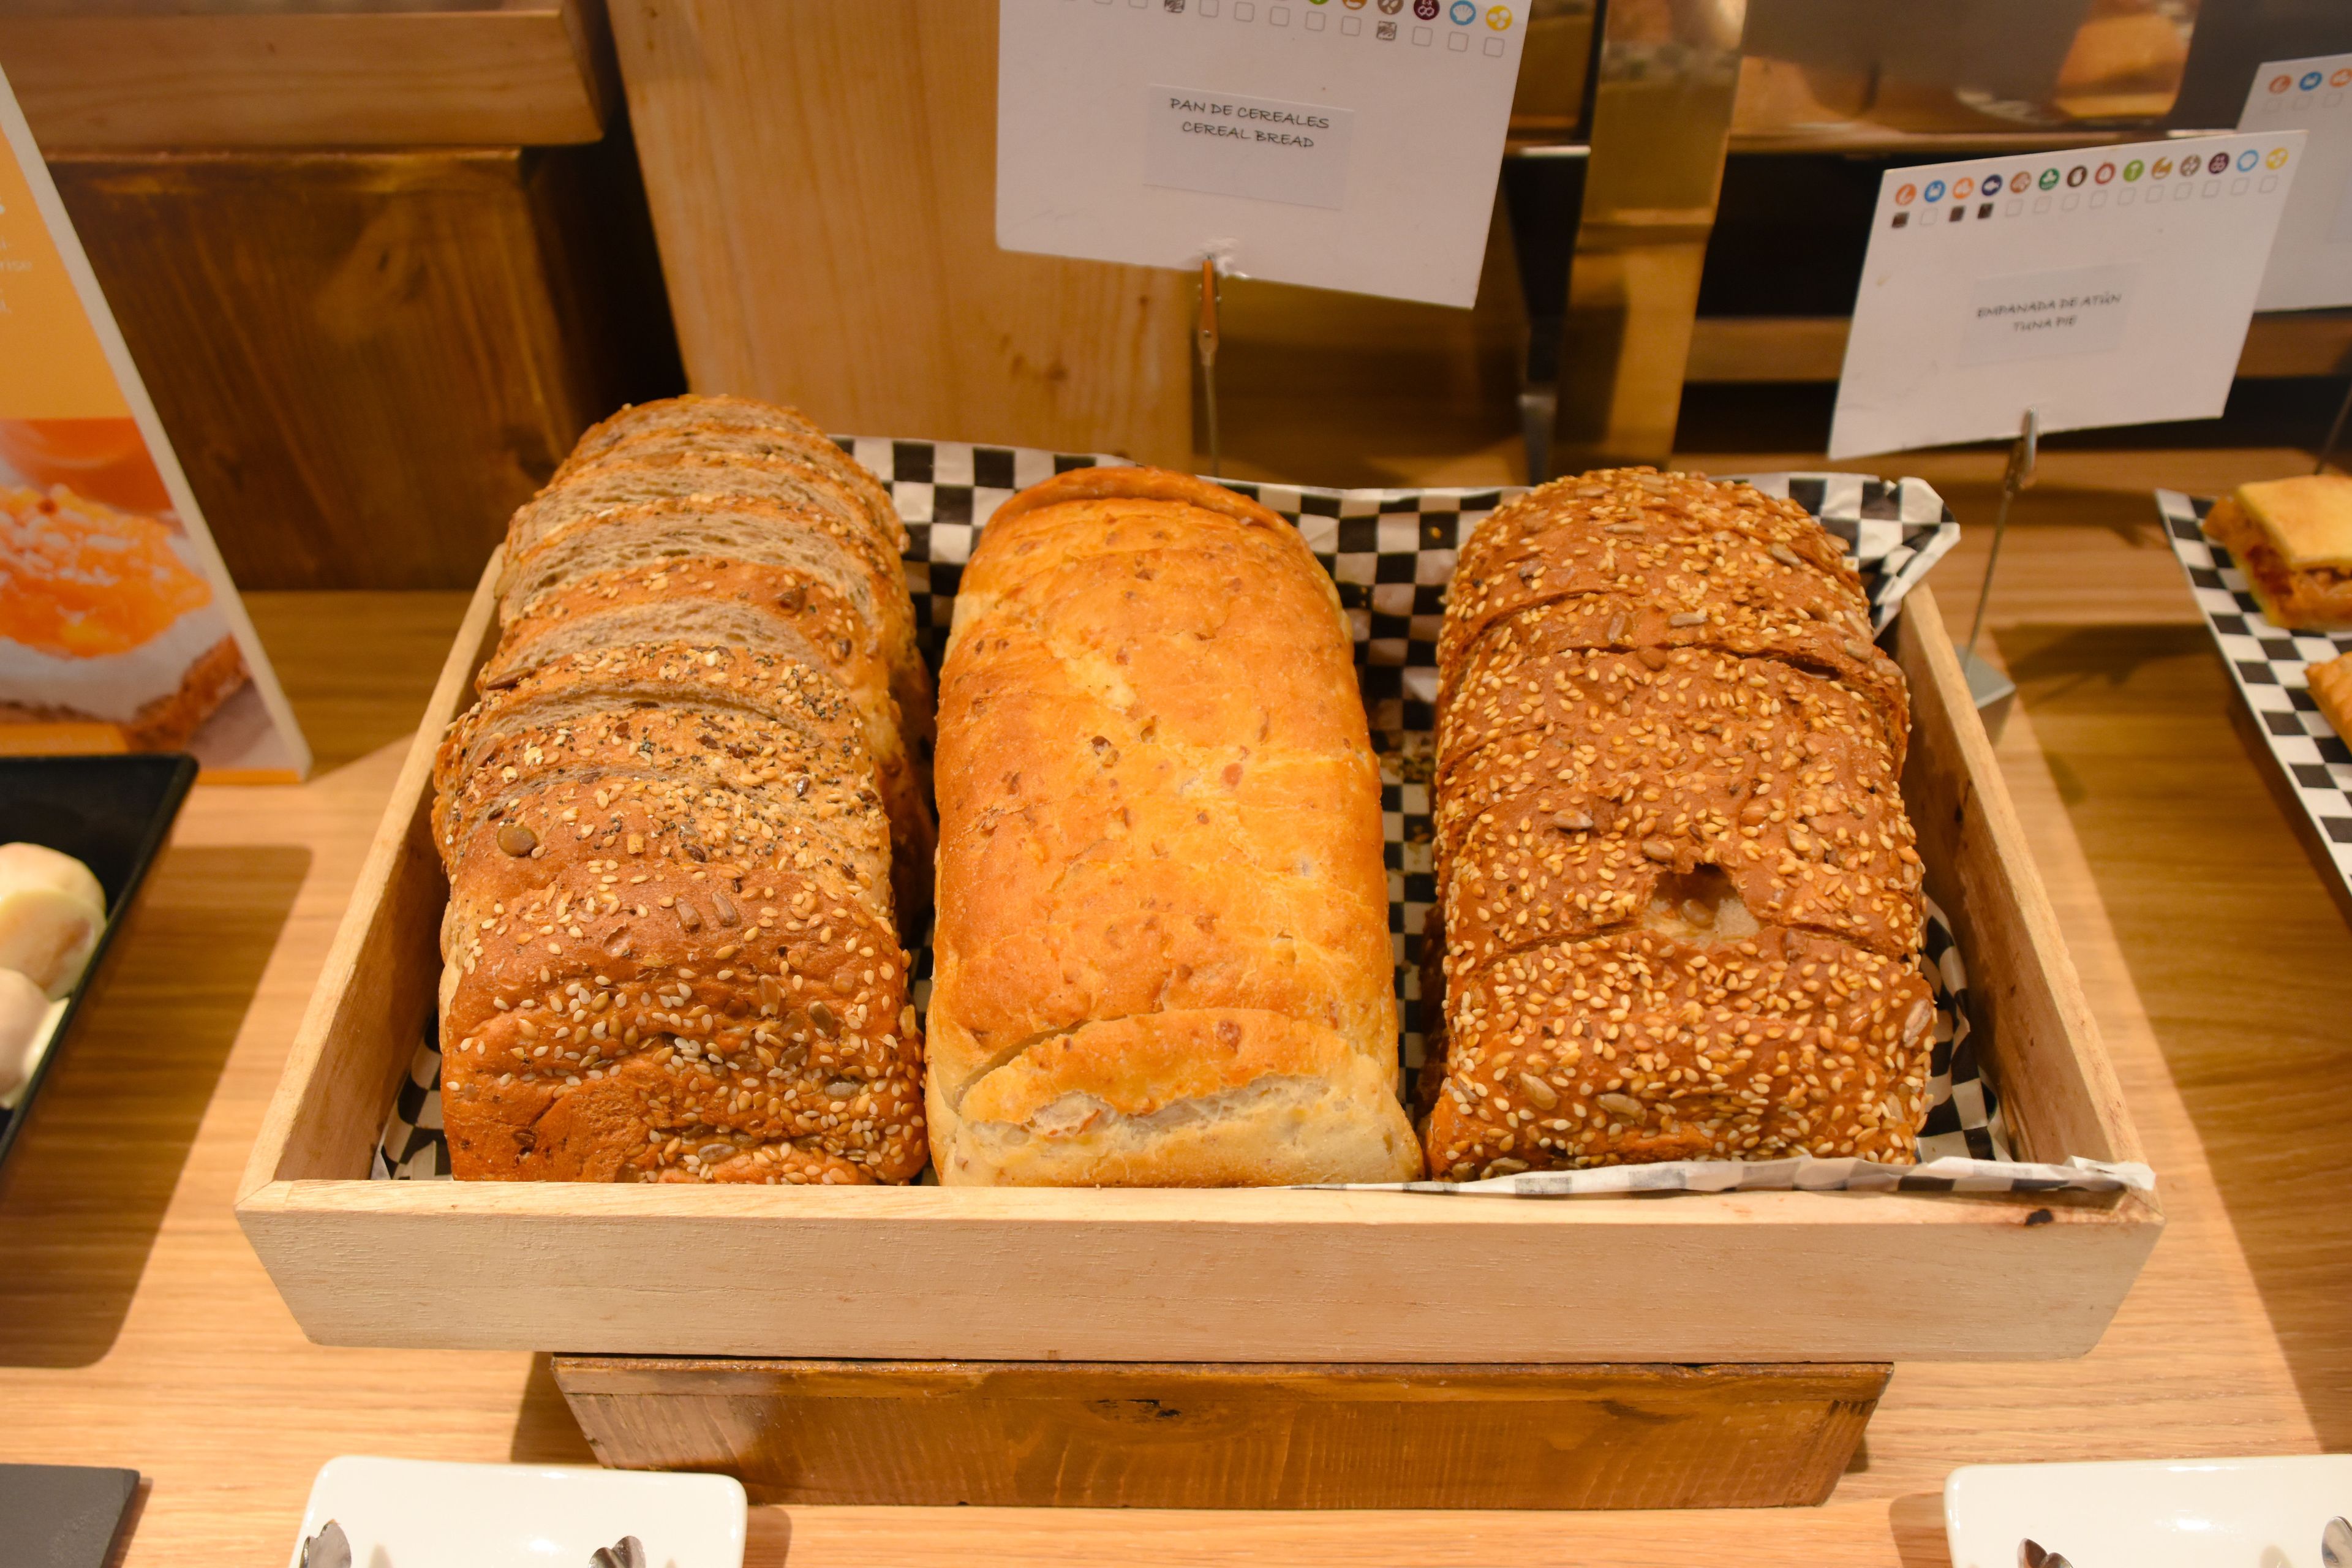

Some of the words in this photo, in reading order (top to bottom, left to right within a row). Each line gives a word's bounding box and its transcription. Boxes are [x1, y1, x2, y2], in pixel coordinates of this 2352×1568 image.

[1170, 98, 1205, 113] PAN
[1211, 103, 1233, 116] DE
[1237, 107, 1330, 129] CEREALES
[1182, 121, 1251, 140] CEREAL
[1254, 130, 1314, 148] BREAD
[1977, 300, 2056, 318] EMPANADA
[2059, 296, 2078, 308] DE
[2082, 290, 2122, 307] ATÚN
[2013, 318, 2052, 332] TUNA
[2056, 315, 2077, 328] PIE
